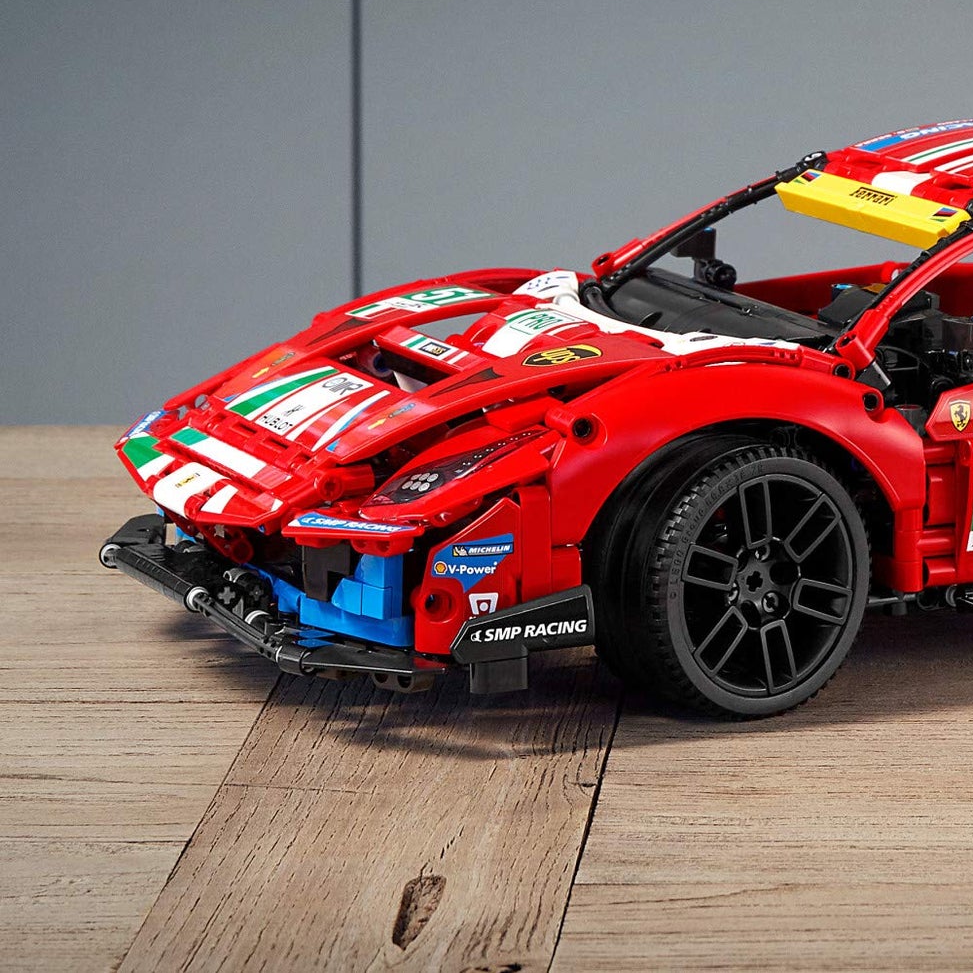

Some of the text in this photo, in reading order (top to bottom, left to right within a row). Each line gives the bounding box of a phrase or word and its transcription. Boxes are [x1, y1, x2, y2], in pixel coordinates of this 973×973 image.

[849, 186, 897, 206] Ferrari
[409, 285, 491, 306] 51
[517, 310, 563, 331] PRO
[533, 347, 581, 366] ups
[262, 414, 294, 433] HUBLOT
[468, 544, 511, 555] MICHELIN
[448, 564, 496, 575] V-Power
[484, 619, 588, 643] SMP RACING
